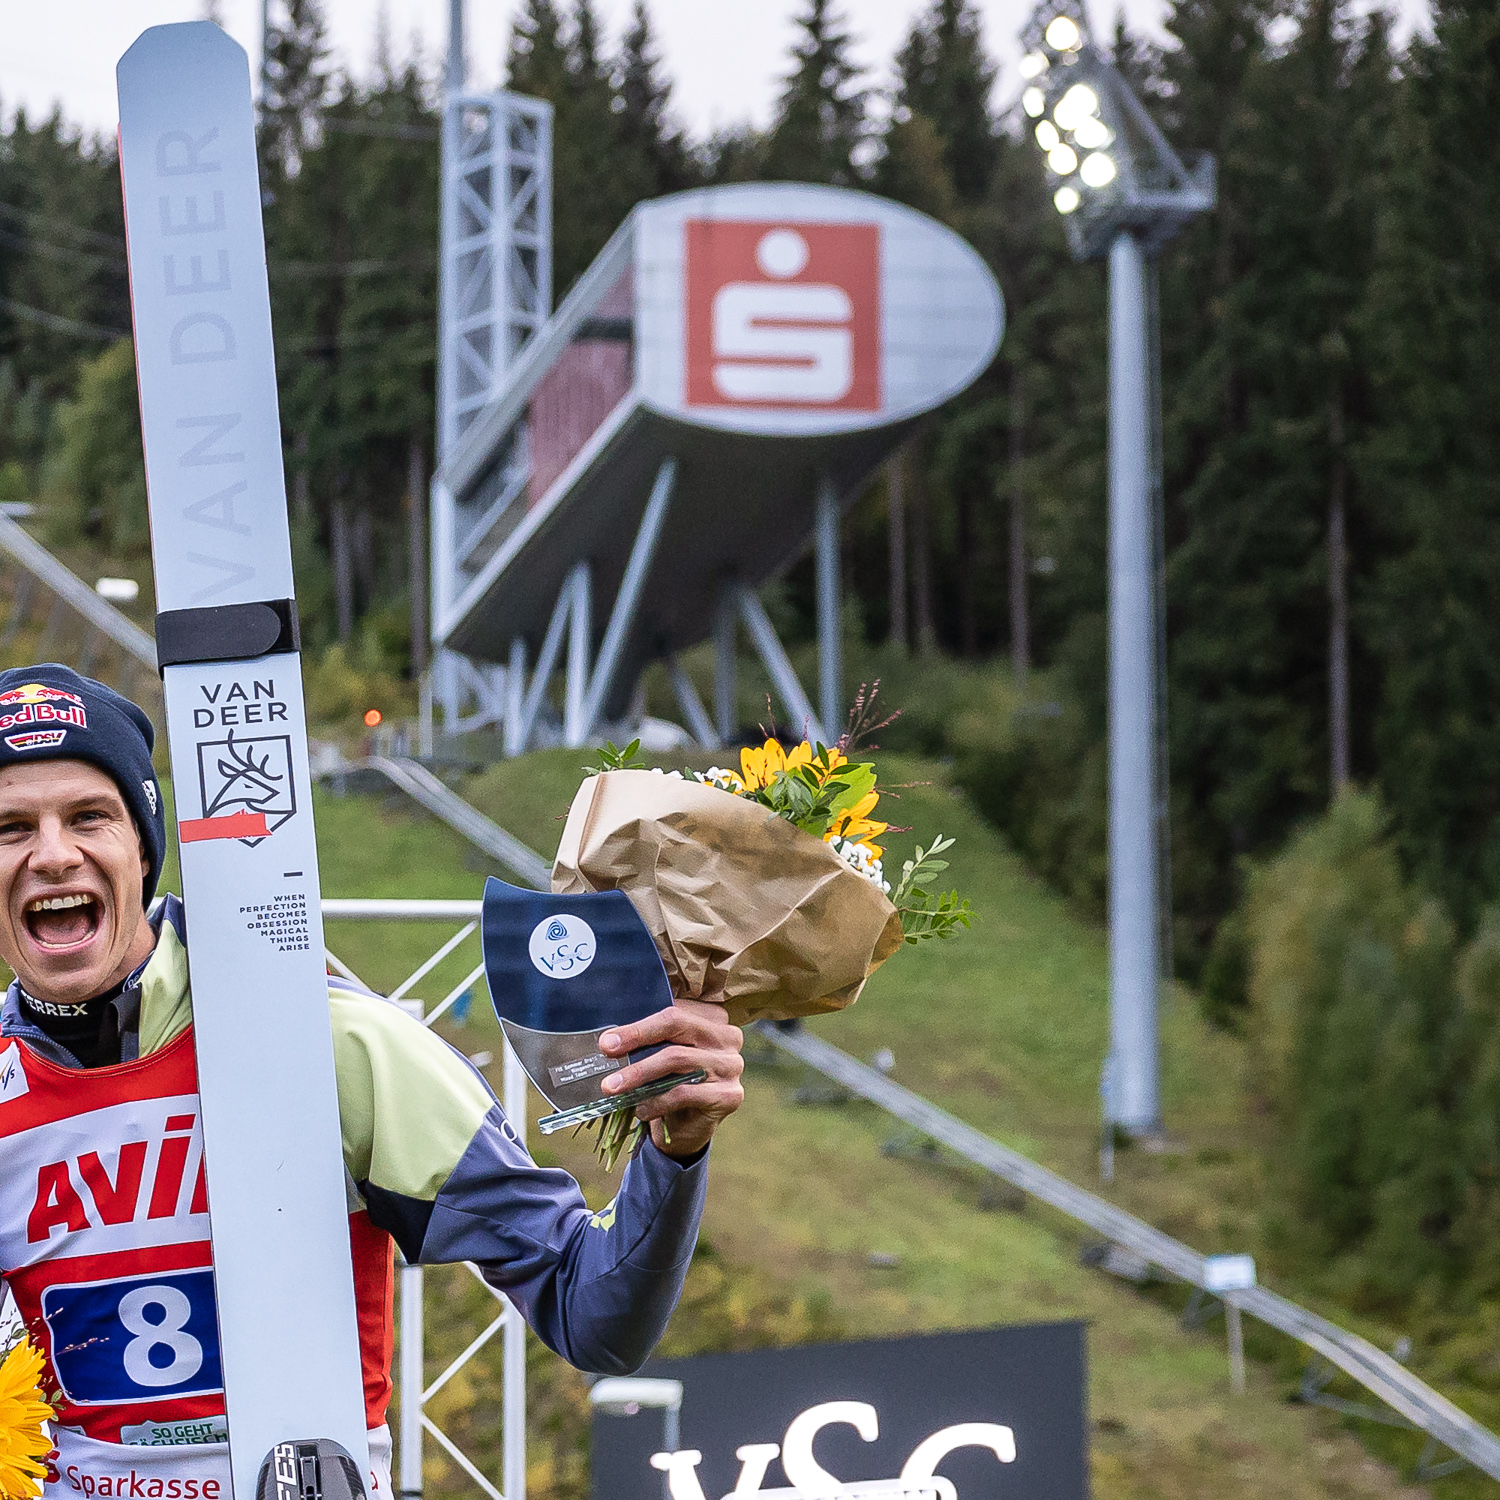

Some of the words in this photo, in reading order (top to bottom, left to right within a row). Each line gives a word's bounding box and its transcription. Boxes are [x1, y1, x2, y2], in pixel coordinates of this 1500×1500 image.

[155, 125, 238, 367] DEER
[200, 679, 275, 704] VAN
[36, 705, 88, 729] Bull
[193, 702, 288, 728] DEER
[274, 893, 306, 903] WHEN
[239, 902, 307, 914] PERFECTION
[257, 910, 307, 920] BECOMES
[247, 918, 308, 930] OBSESSION
[260, 927, 309, 937] MAGICAL
[270, 935, 310, 944] THINGS
[278, 943, 311, 952] ARISE
[117, 1284, 204, 1387] 8
[151, 1426, 172, 1440] SO
[173, 1422, 215, 1439] GEHT
[66, 1464, 221, 1500] Sparkasse
